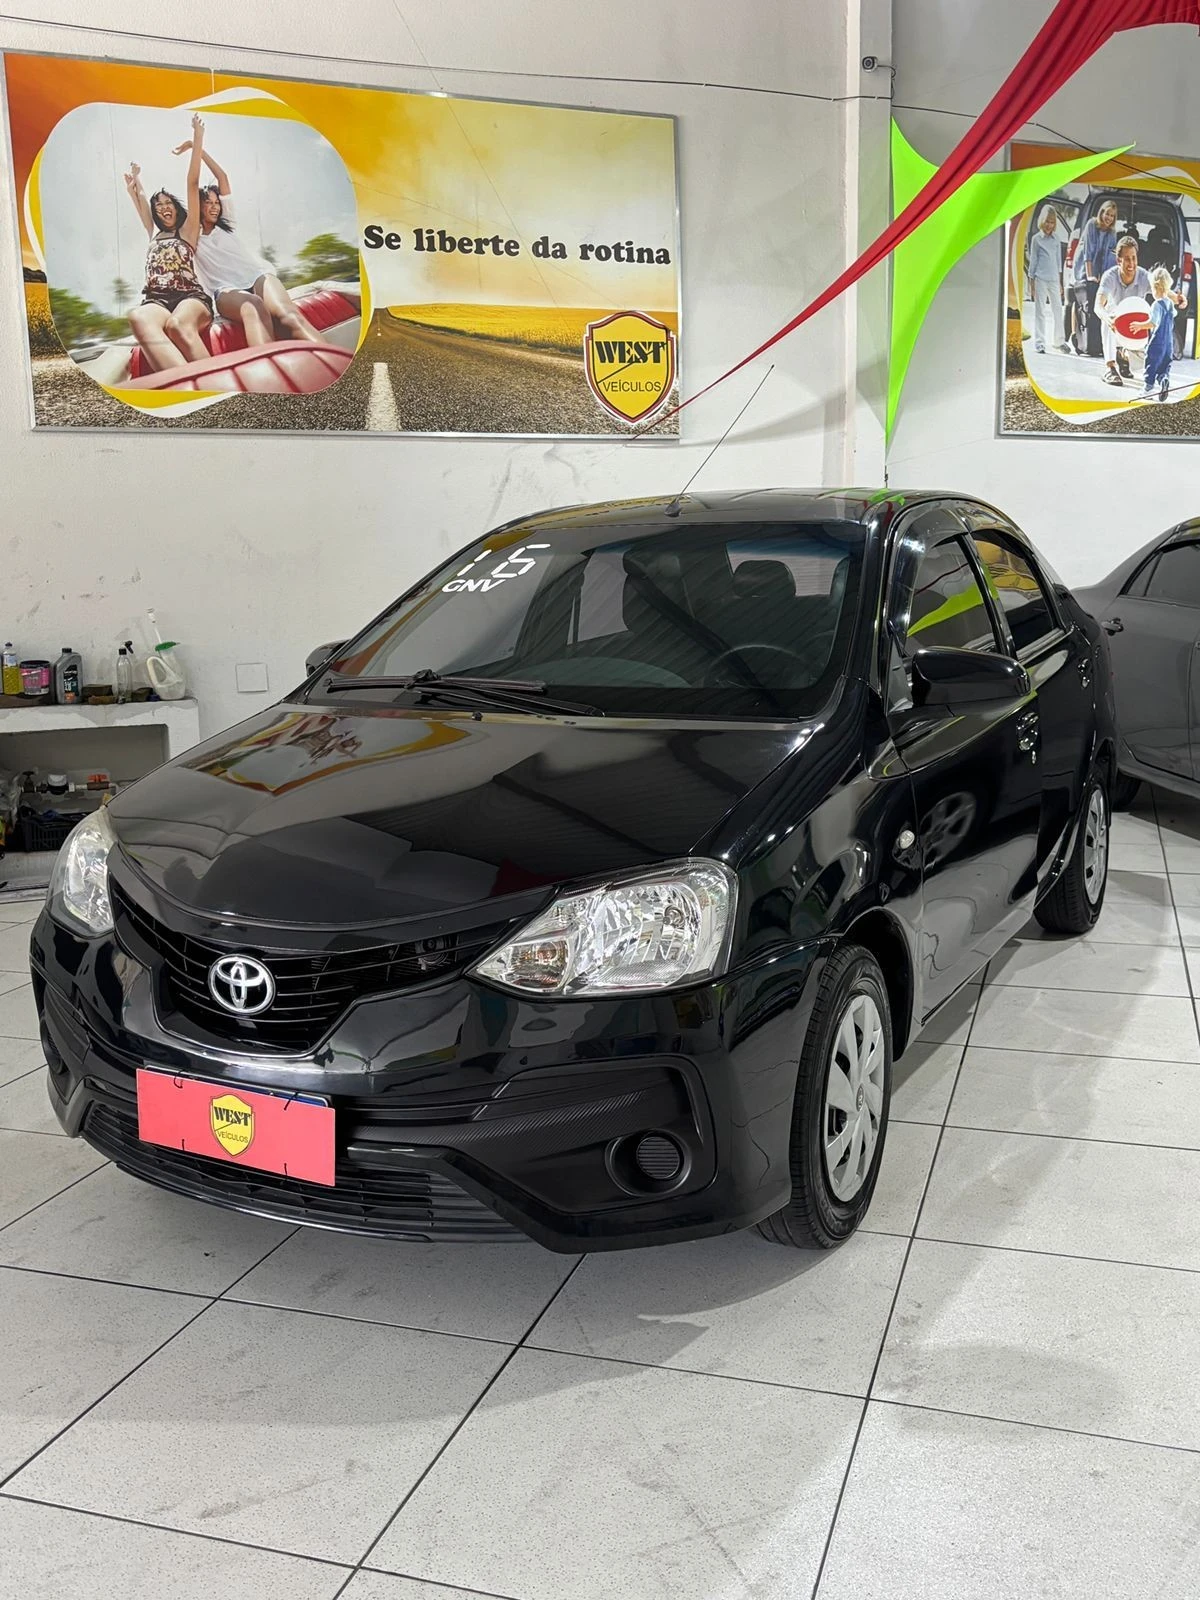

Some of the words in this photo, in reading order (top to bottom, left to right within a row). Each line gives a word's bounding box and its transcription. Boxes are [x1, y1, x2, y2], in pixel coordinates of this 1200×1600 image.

[364, 225, 401, 250] Se
[413, 228, 520, 256] liberte
[532, 236, 567, 259] da
[579, 240, 671, 264] rotina
[595, 341, 666, 363] WEST
[603, 379, 662, 392] VEÍCULOS
[442, 579, 506, 592] GNV
[214, 1106, 251, 1126] WEST
[217, 1130, 248, 1143] VEÍCULOS
